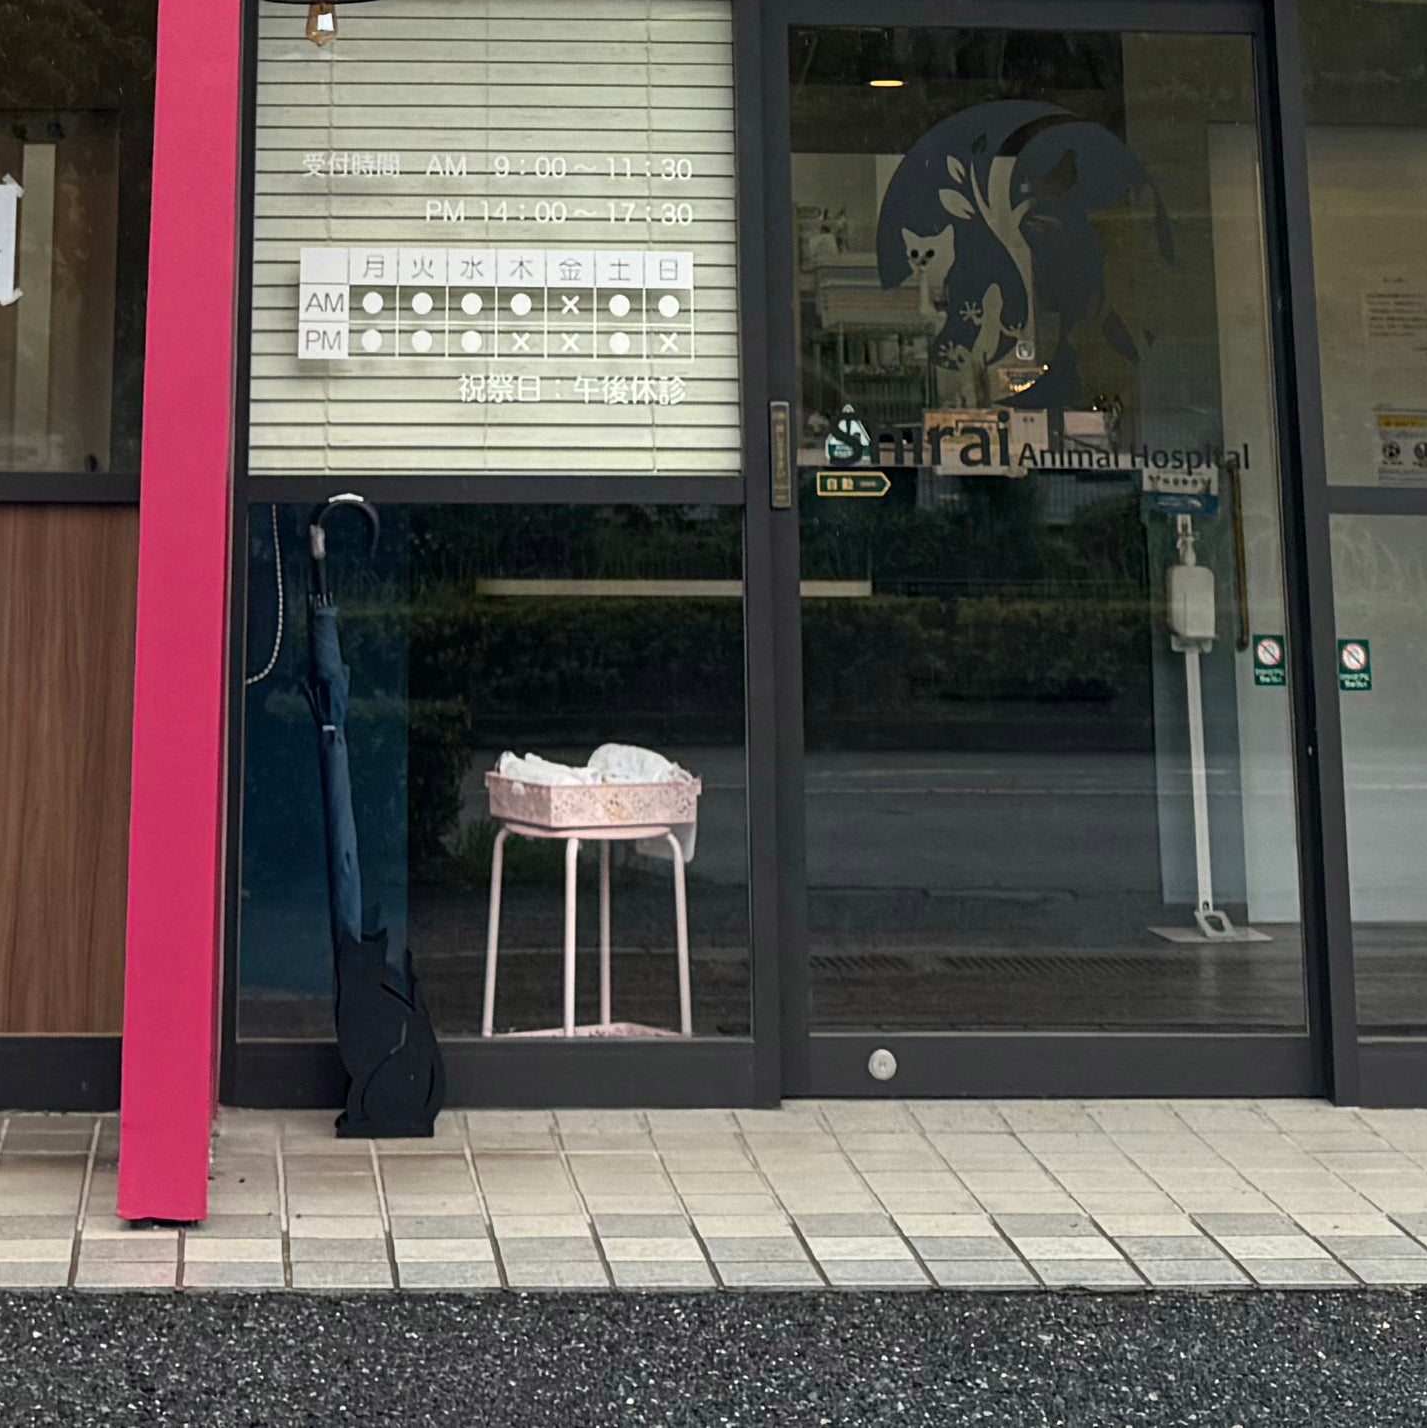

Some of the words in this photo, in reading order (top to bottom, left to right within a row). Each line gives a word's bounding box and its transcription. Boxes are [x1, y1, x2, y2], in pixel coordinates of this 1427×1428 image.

[303, 152, 401, 178] 受付時間
[425, 154, 467, 178] AM
[425, 200, 465, 223] PM
[363, 254, 385, 279] 月
[411, 255, 435, 280] 火
[460, 255, 484, 280] 水
[509, 255, 534, 281] 木
[558, 257, 583, 282] 金
[608, 257, 632, 282] 土
[658, 258, 679, 282] 日
[305, 292, 345, 313] AM
[305, 329, 342, 351] PM
[1018, 442, 1119, 470] Animal
[1131, 443, 1250, 476] Hospital
